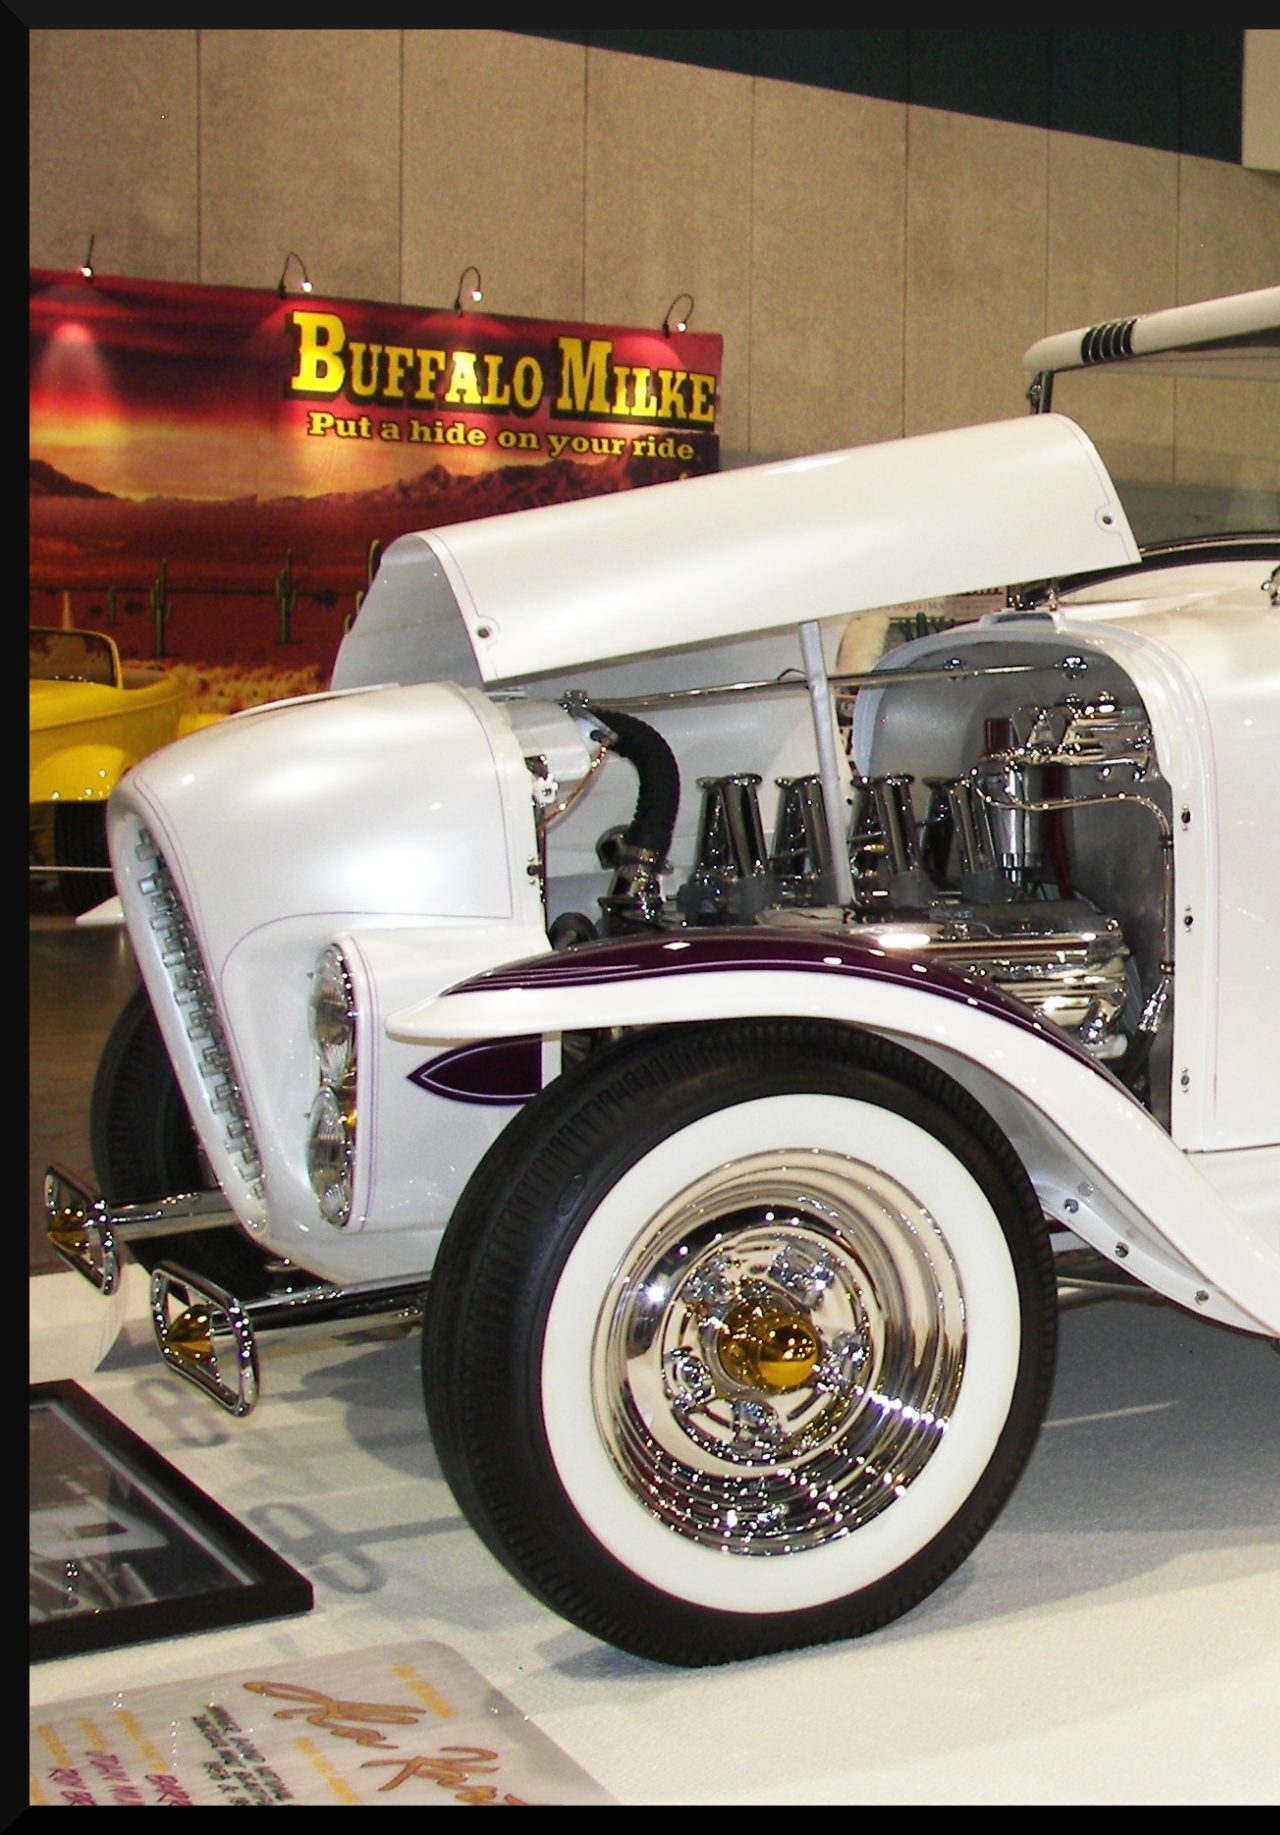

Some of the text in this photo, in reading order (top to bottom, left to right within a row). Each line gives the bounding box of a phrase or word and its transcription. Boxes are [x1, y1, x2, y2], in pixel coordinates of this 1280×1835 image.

[290, 311, 717, 424] BUFFALO MILKE
[309, 411, 695, 460] Put a hide on your ride
